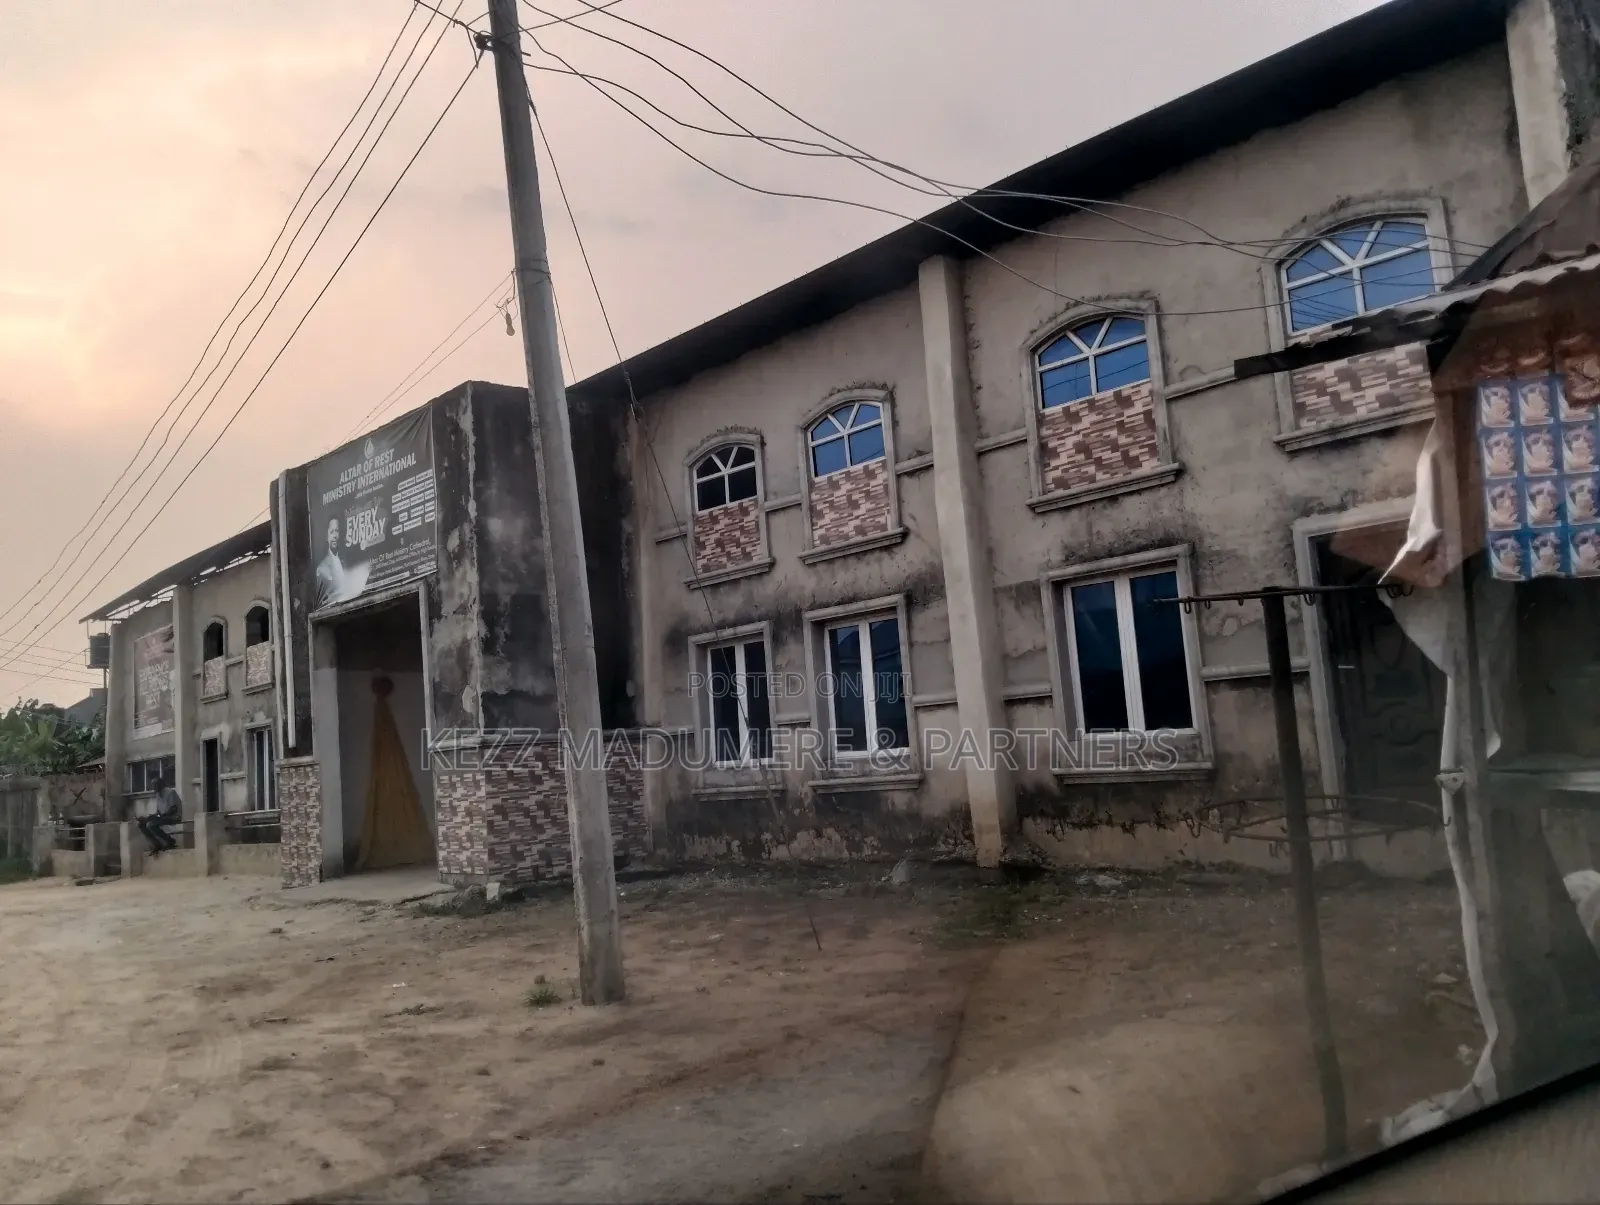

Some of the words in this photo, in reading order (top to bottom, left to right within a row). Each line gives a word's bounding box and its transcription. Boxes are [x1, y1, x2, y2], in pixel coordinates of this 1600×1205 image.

[322, 480, 357, 506] MINISTRY
[357, 452, 417, 490] INTERNATIONAL
[339, 465, 362, 485] ALTAR
[363, 458, 375, 473] OF
[375, 448, 395, 469] REST
[345, 517, 386, 548] SUNDAY
[346, 505, 379, 530] EVERY
